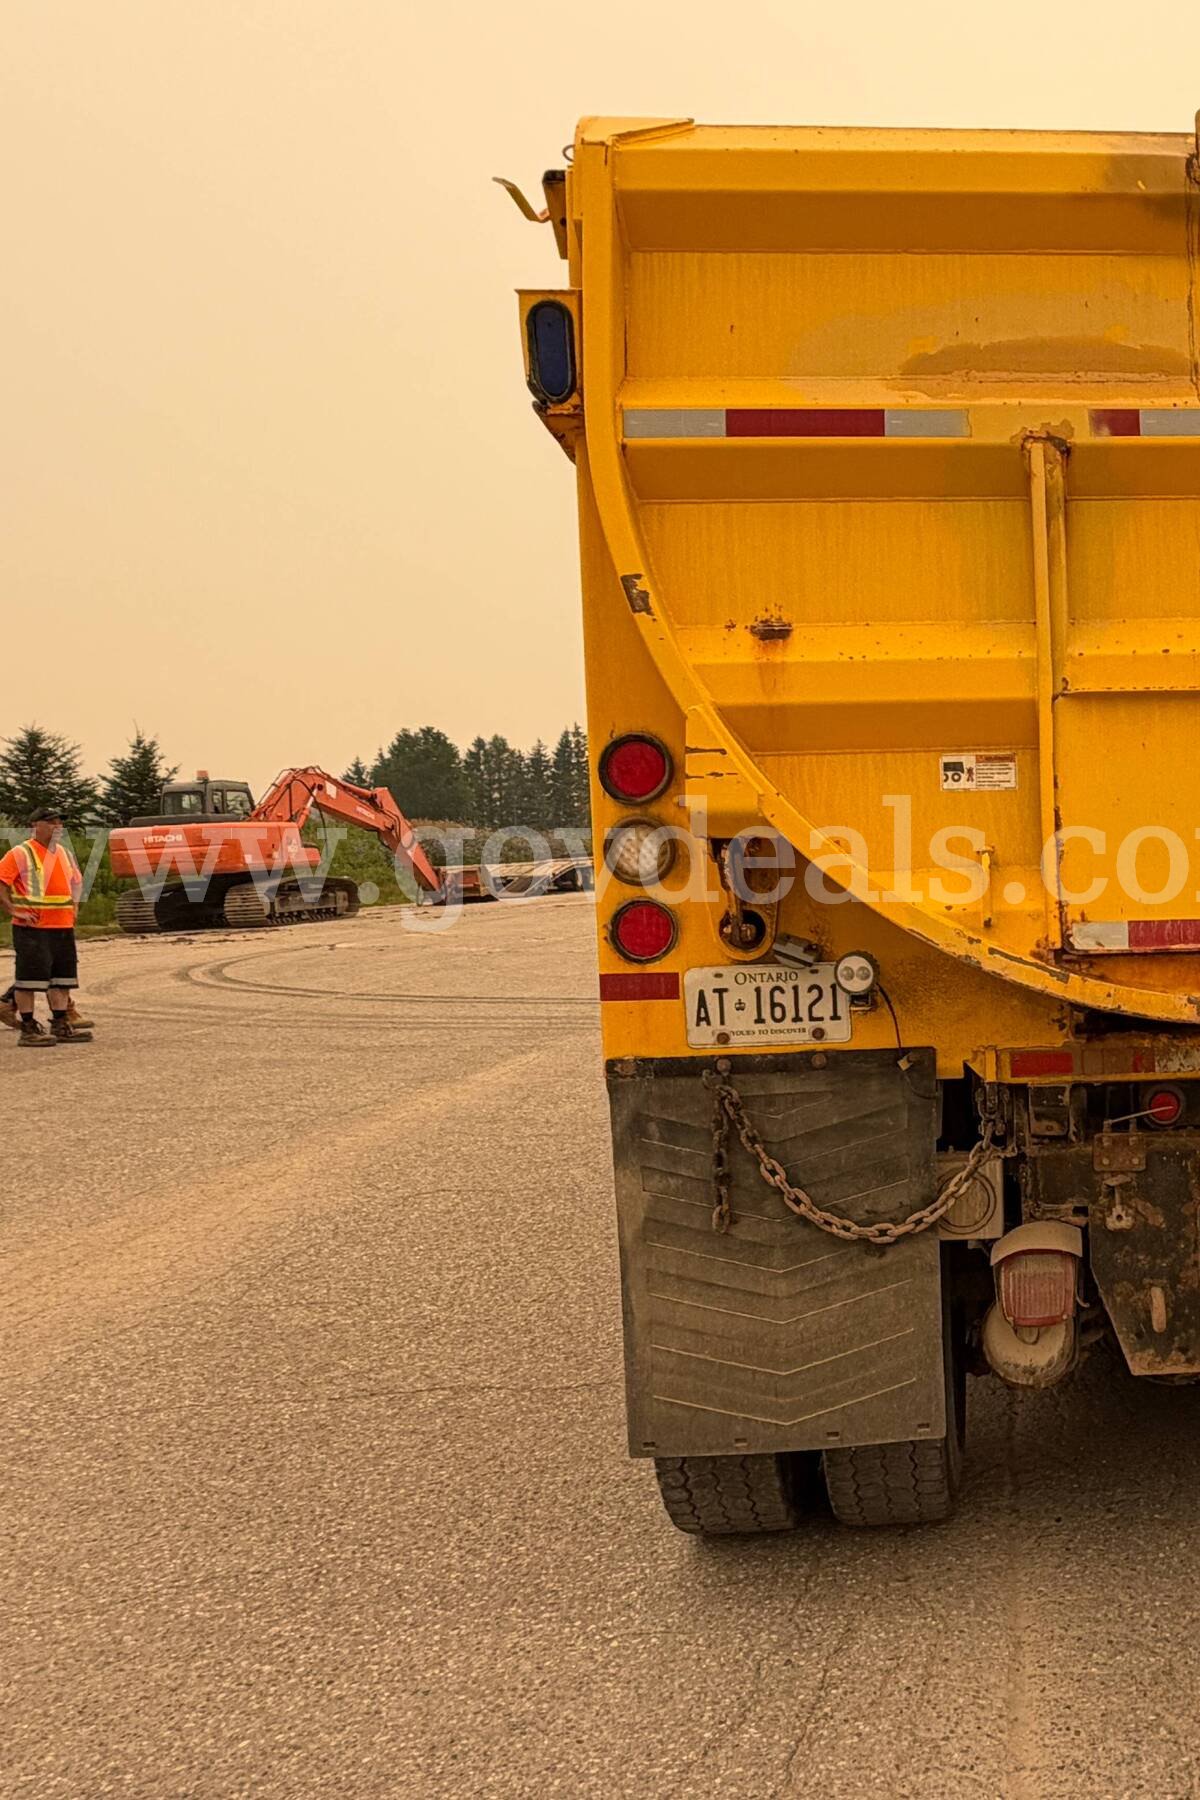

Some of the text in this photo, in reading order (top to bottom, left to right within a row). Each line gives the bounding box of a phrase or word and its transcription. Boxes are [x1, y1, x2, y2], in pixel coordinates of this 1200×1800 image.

[143, 834, 183, 844] HITACHI
[734, 971, 799, 985] ONTARIO
[695, 983, 842, 1027] AT 16121
